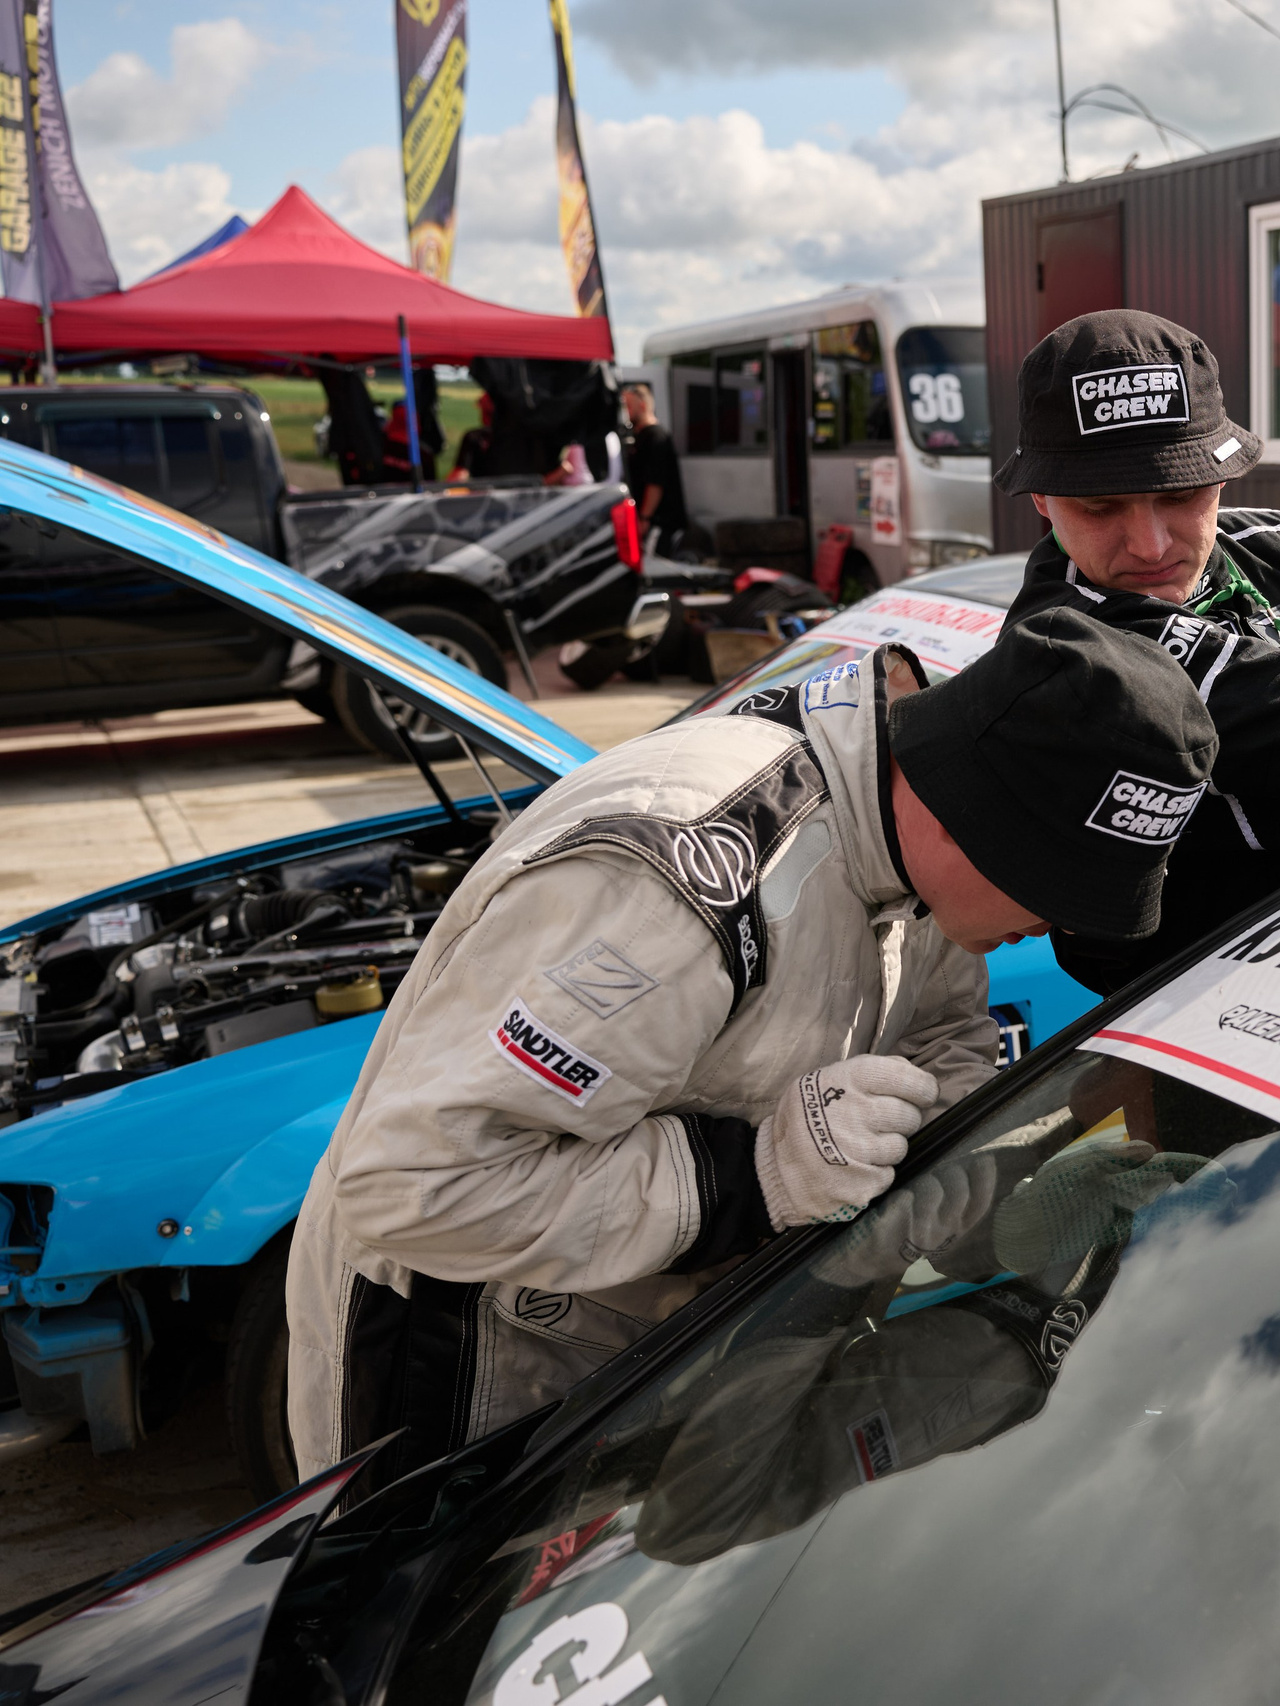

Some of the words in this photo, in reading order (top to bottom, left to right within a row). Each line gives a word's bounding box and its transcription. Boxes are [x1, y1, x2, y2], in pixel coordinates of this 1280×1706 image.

[0, 126, 30, 252] GARAGE
[909, 373, 965, 423] 36
[1079, 371, 1179, 401] CHASER
[1094, 394, 1172, 423] CREW
[1167, 615, 1206, 660] OM
[1112, 781, 1200, 815] CHASE
[1111, 808, 1184, 837] CREW
[503, 1009, 600, 1090] SANDTLER
